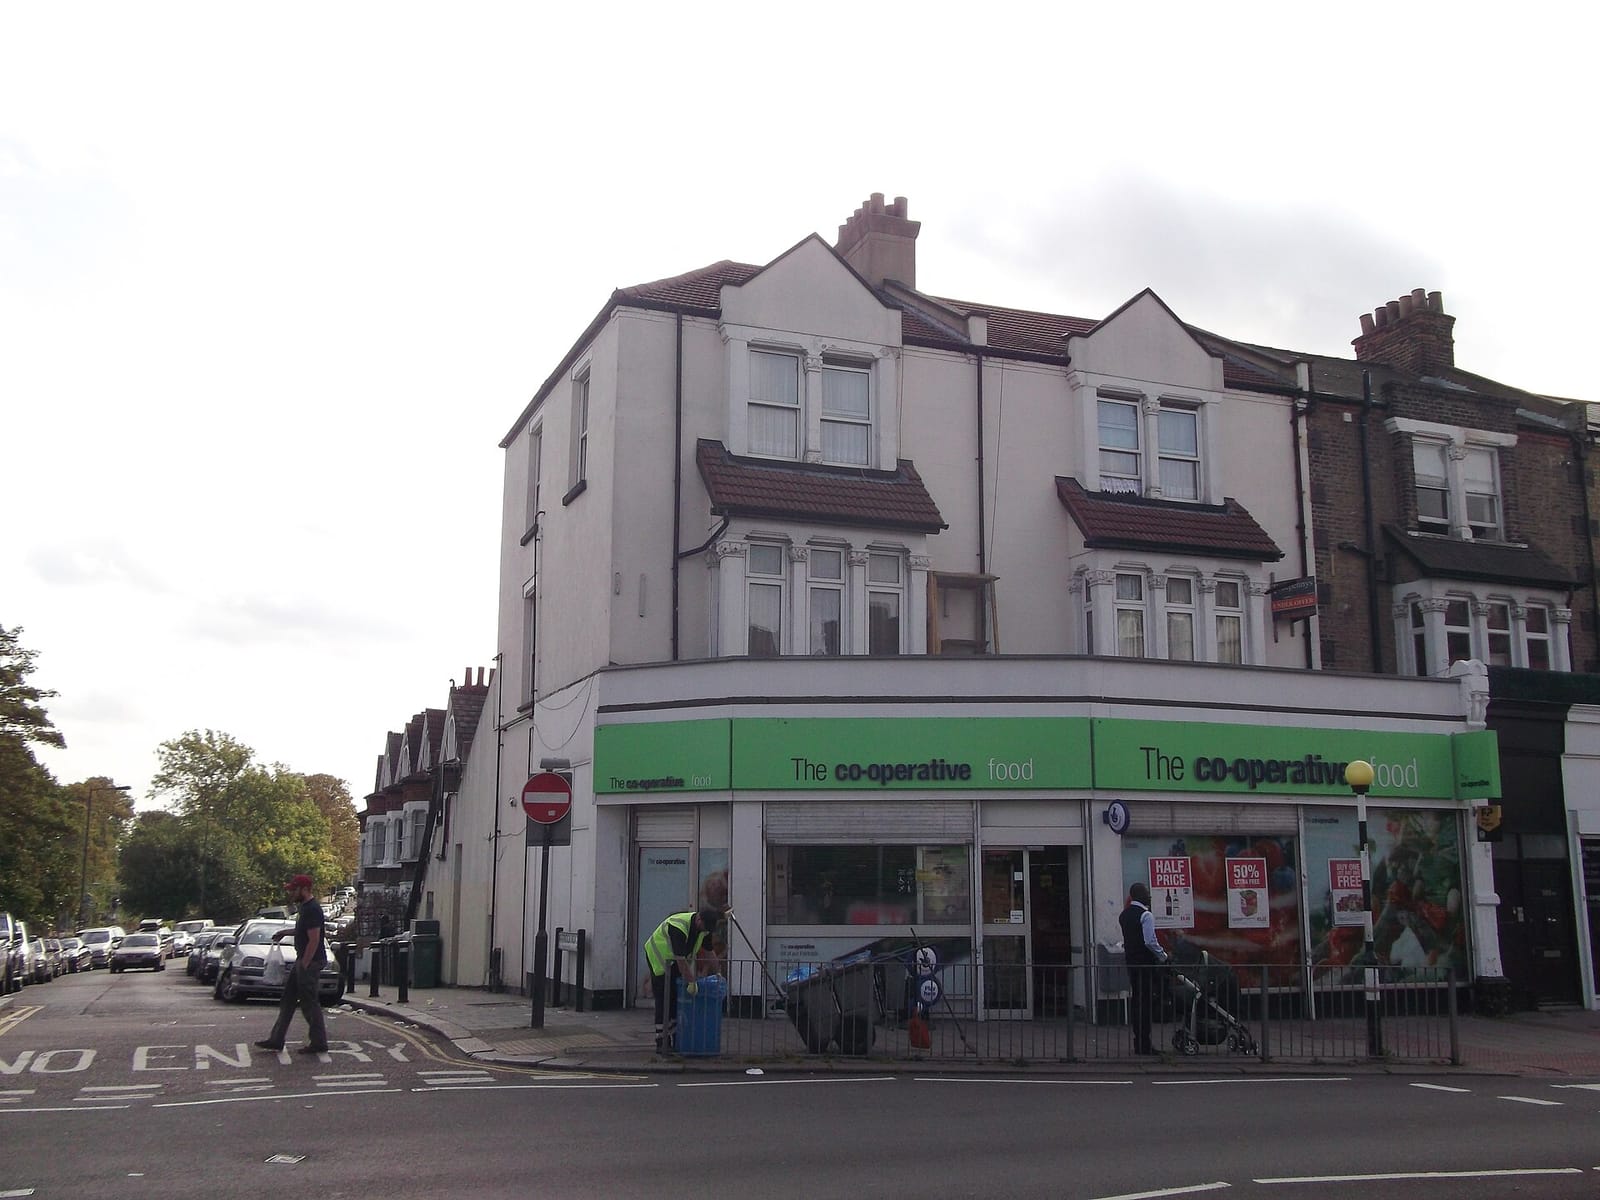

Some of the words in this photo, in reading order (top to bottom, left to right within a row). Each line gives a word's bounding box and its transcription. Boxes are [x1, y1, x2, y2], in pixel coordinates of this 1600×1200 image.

[1139, 746, 1184, 781] The
[791, 758, 827, 781] The
[835, 759, 972, 786] co-operative
[988, 758, 1034, 780] food
[610, 777, 625, 789] The
[626, 776, 684, 790] co-operative
[691, 774, 712, 786] food
[1155, 860, 1185, 873] HALF
[1233, 864, 1259, 878] 50%
[1156, 874, 1185, 886] PRICE
[1337, 875, 1362, 888] FREE
[0, 1049, 97, 1075] NO
[132, 1040, 411, 1071] ENTRY
